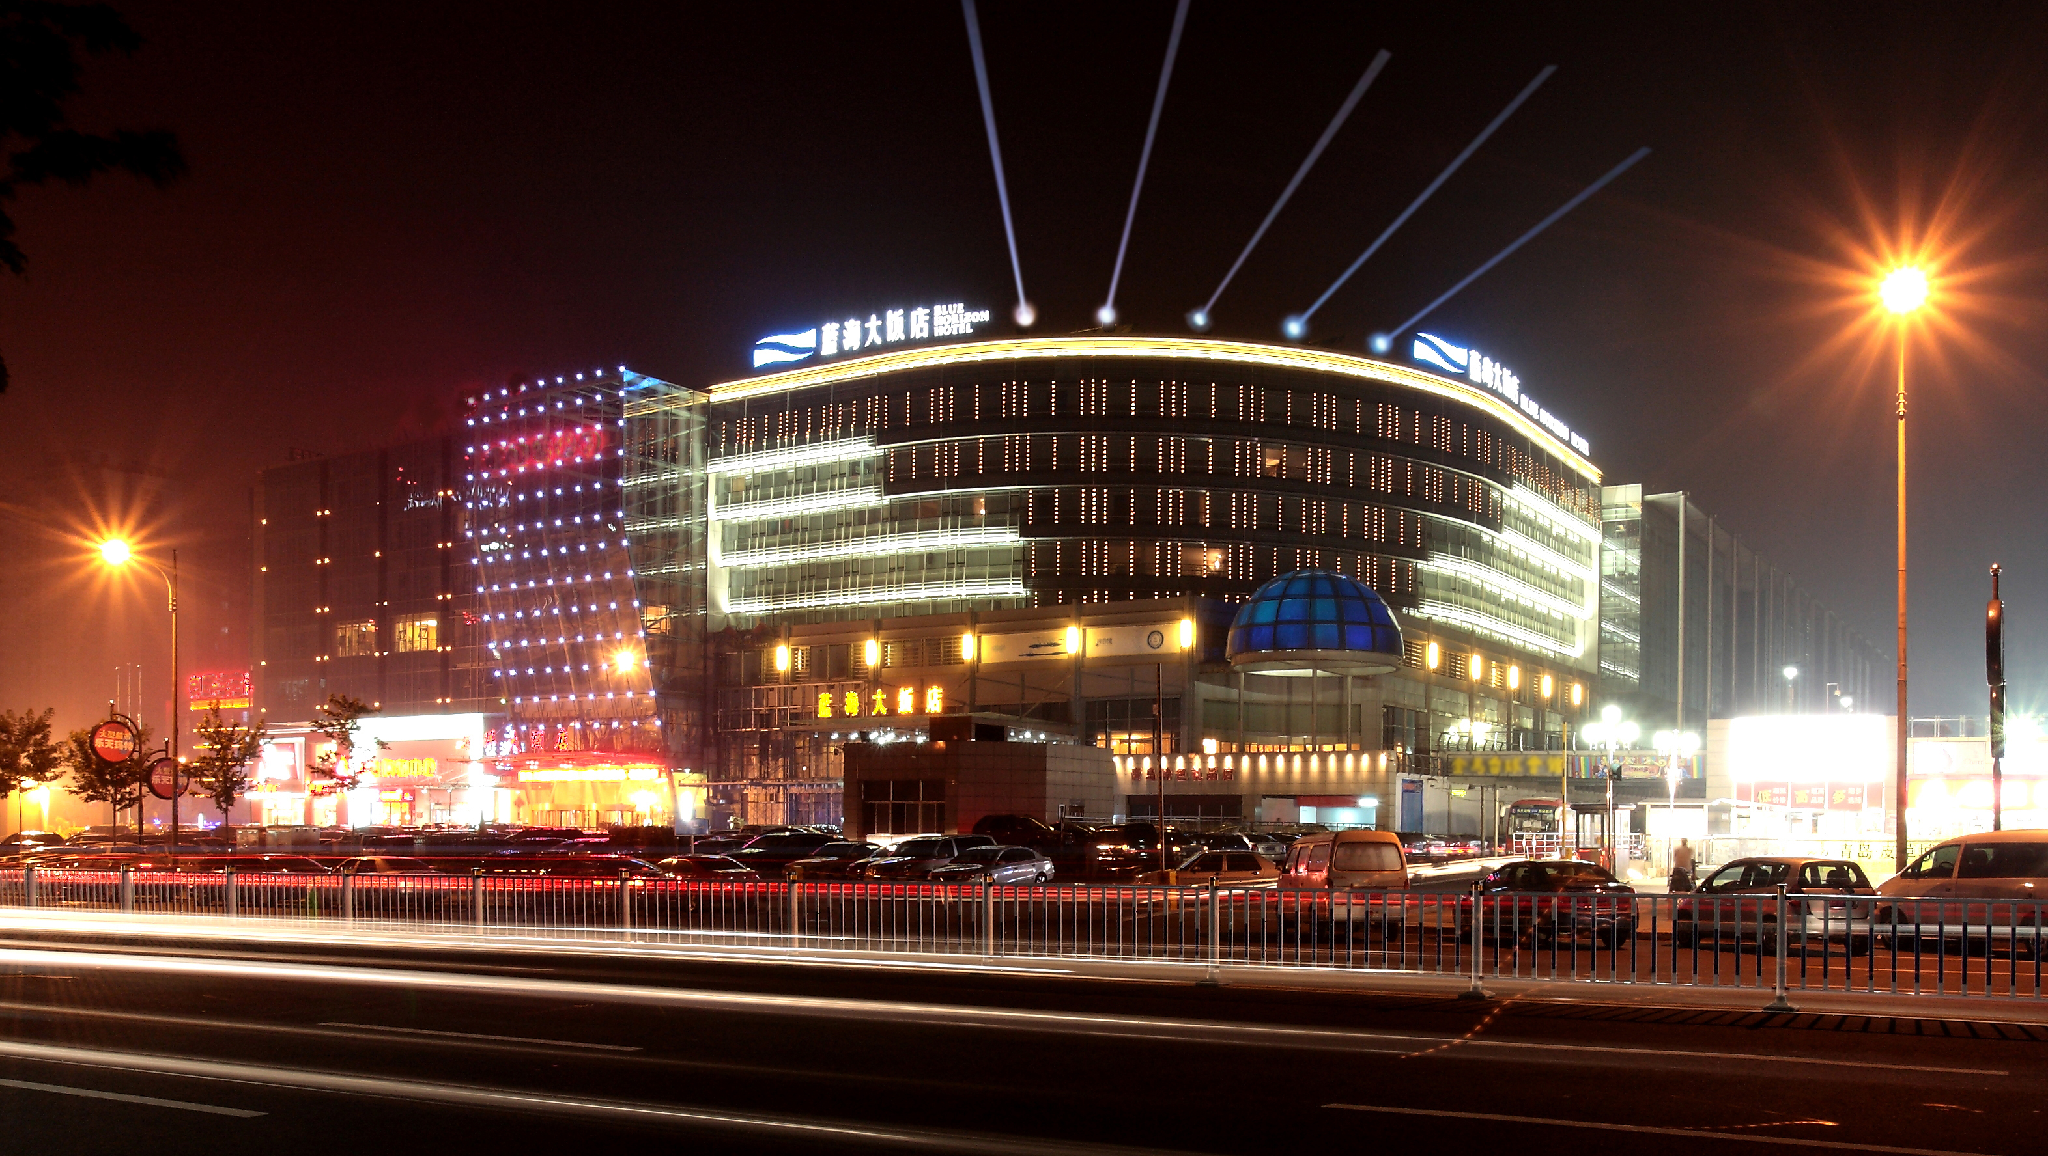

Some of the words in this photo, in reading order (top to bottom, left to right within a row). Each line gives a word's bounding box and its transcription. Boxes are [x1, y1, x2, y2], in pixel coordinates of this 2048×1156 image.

[933, 303, 965, 315] BLUE
[933, 310, 990, 327] HORIZON
[820, 306, 929, 356] 蓝海大饭店
[933, 321, 974, 337] HOTEL
[817, 685, 943, 718] 蓝海大饭店
